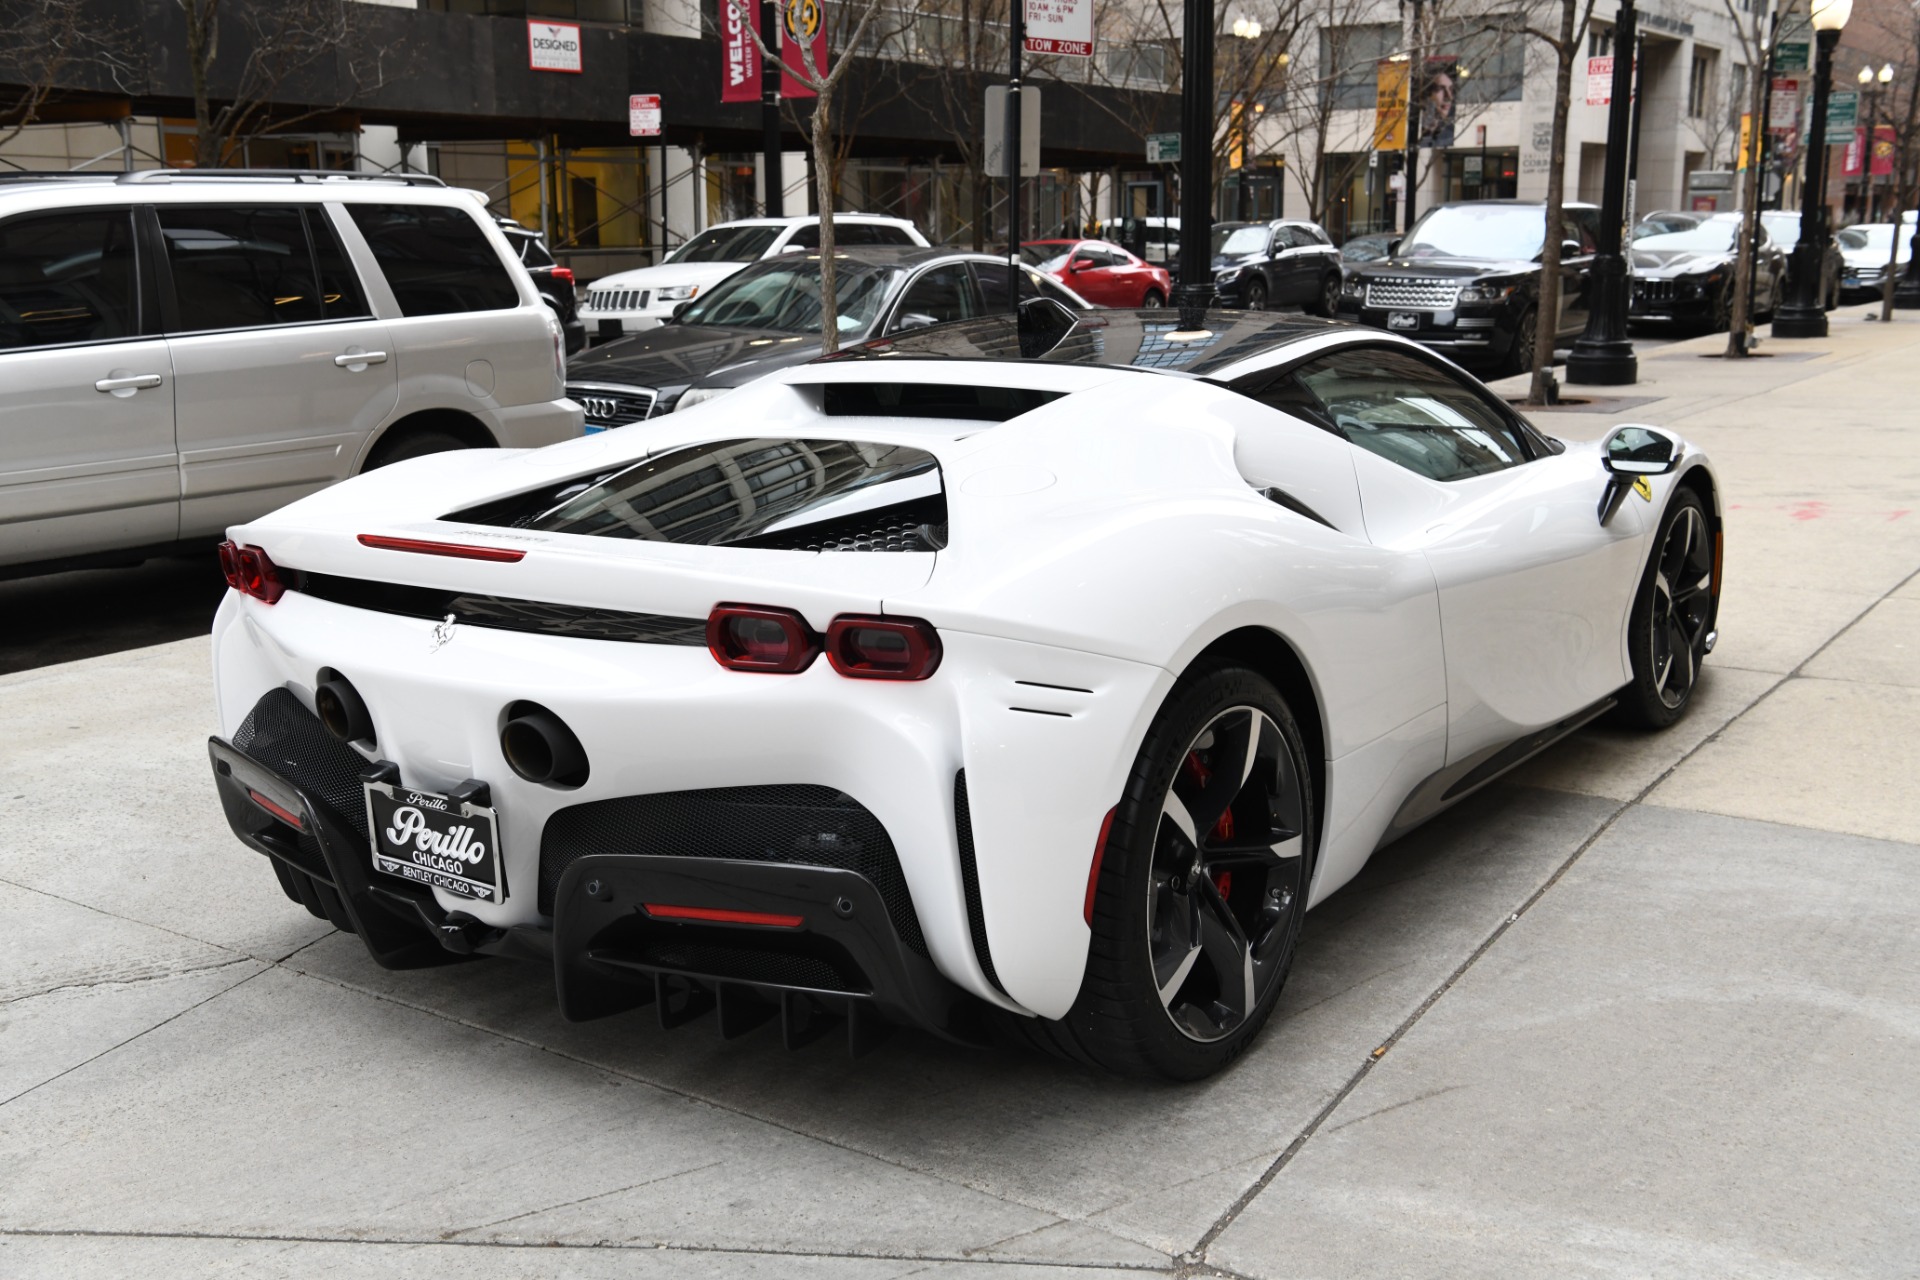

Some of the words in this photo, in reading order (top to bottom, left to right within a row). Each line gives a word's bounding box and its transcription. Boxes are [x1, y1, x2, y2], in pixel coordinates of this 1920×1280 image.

[1029, 11, 1041, 20] FRI
[1047, 13, 1063, 23] SUN
[533, 37, 578, 52] DESIGNED
[727, 0, 744, 86] WELCO
[1028, 39, 1052, 51] TOW
[1058, 41, 1087, 54] ZONE
[745, 46, 753, 78] WATER
[406, 792, 448, 811] Perillo
[386, 806, 485, 865] Perillo
[412, 850, 463, 875] CHICAGO
[403, 865, 433, 883] BENTLEY
[433, 874, 470, 894] CHICAGO
